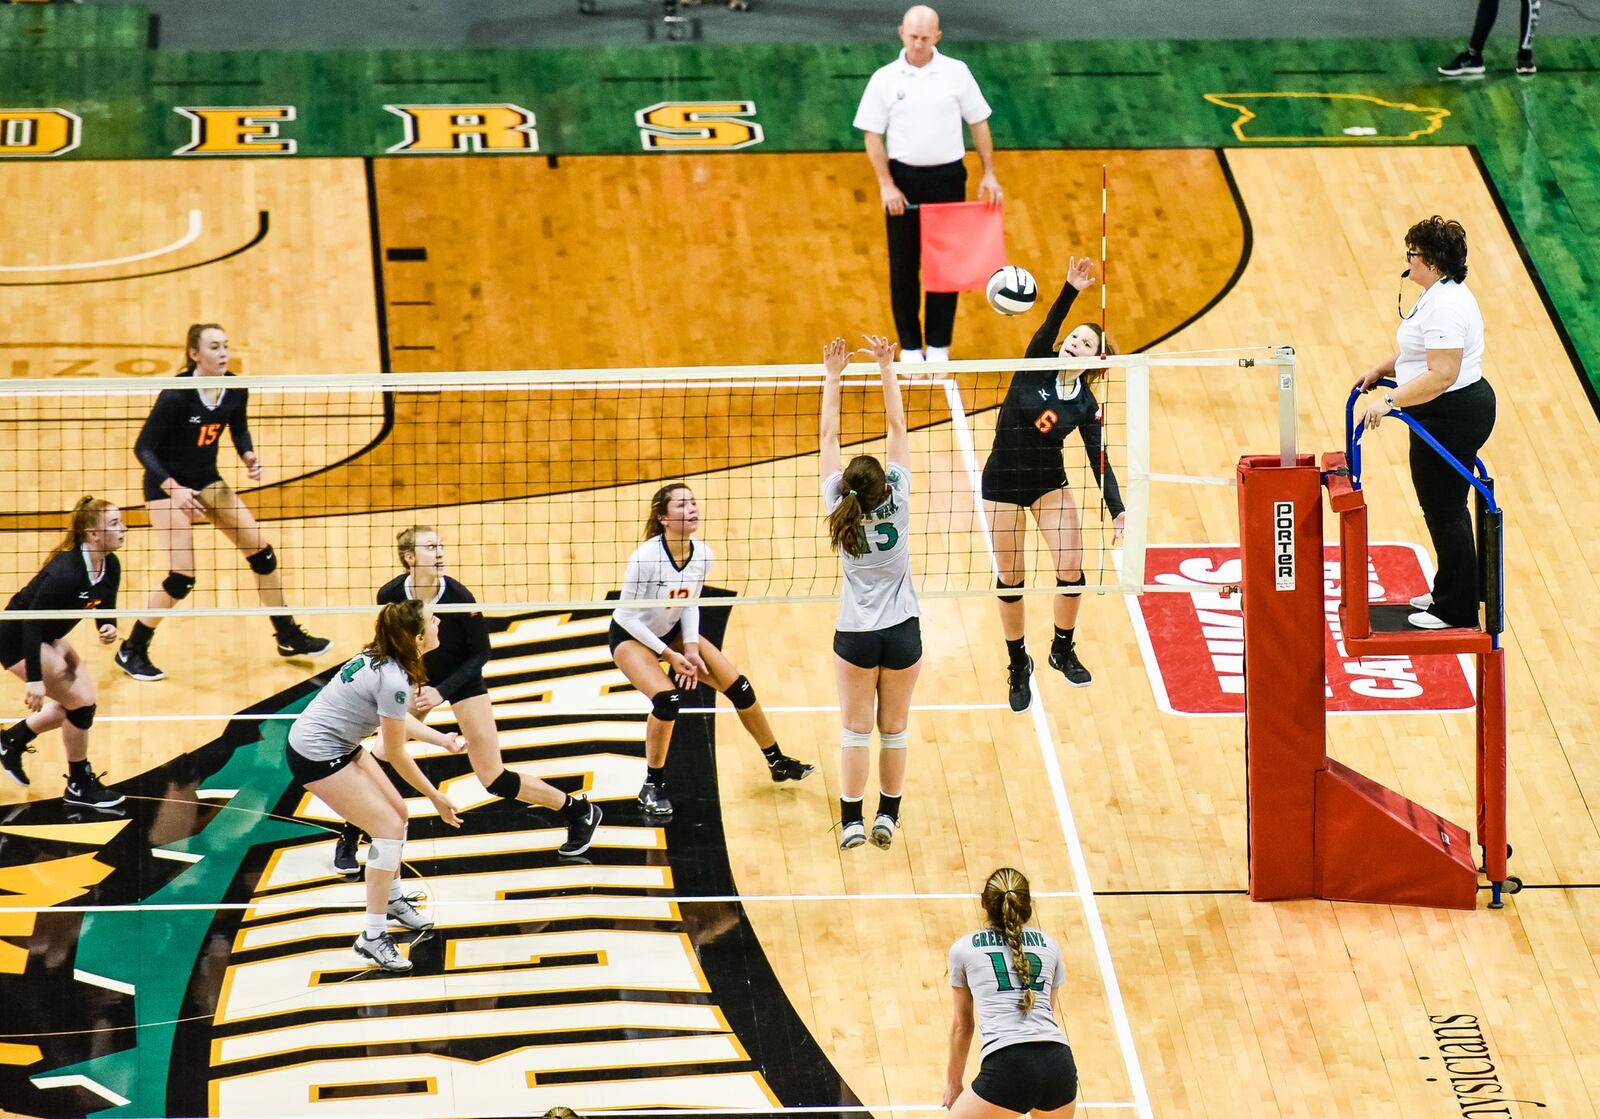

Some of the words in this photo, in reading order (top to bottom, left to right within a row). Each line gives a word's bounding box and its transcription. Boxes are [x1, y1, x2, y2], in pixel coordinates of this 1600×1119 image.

[1034, 408, 1060, 434] 6
[197, 423, 222, 448] 15
[1276, 503, 1293, 578] PORTER
